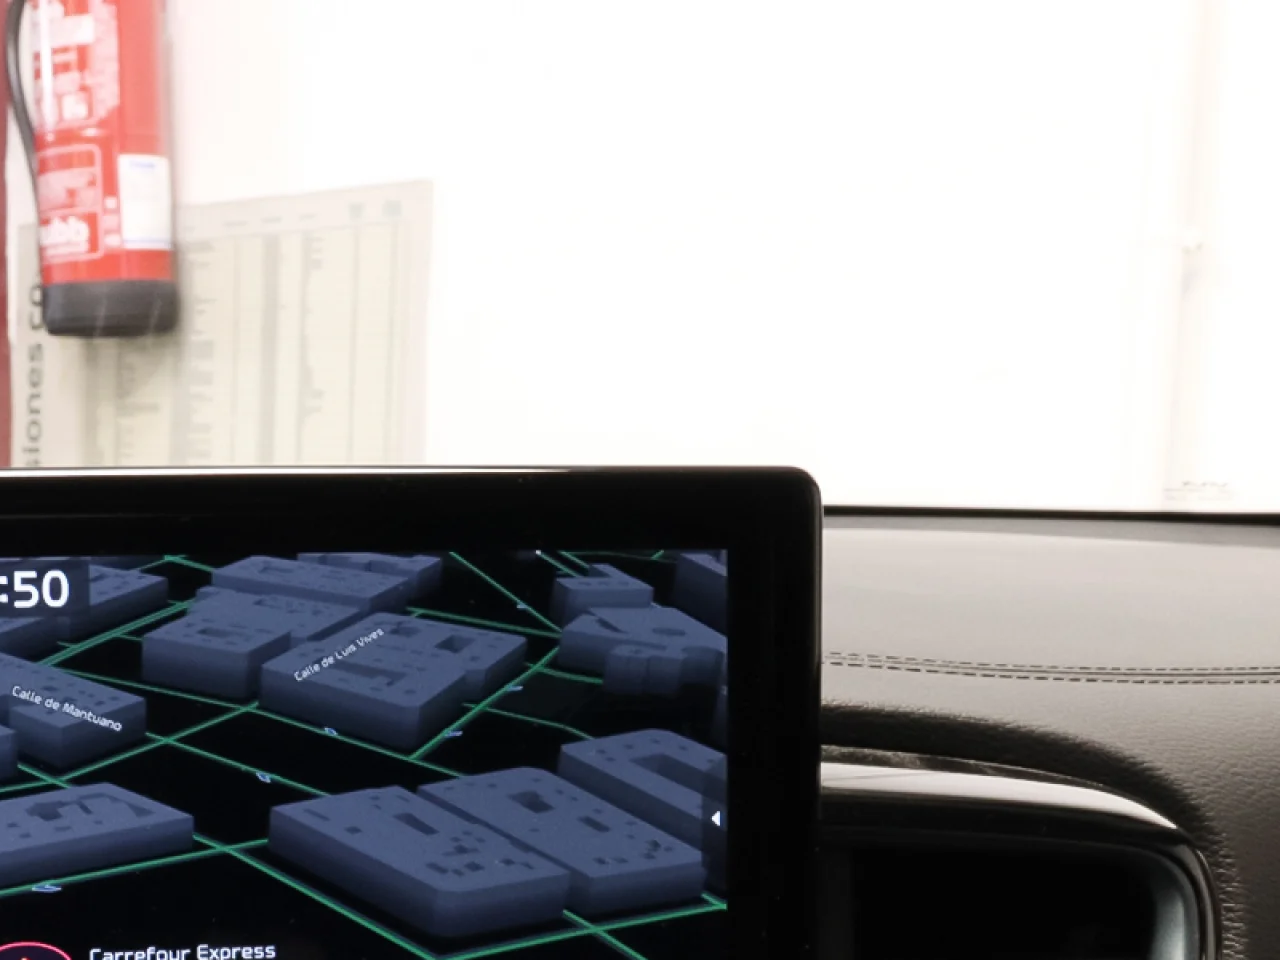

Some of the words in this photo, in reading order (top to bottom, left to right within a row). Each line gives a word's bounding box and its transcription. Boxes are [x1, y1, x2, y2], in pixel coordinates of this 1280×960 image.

[294, 663, 320, 682] Calle
[321, 656, 335, 668] de
[335, 644, 357, 659] Luis
[356, 628, 384, 647] Vives
[12, 685, 42, 705] Calle
[44, 698, 60, 710] de
[61, 702, 123, 732] Mantuano
